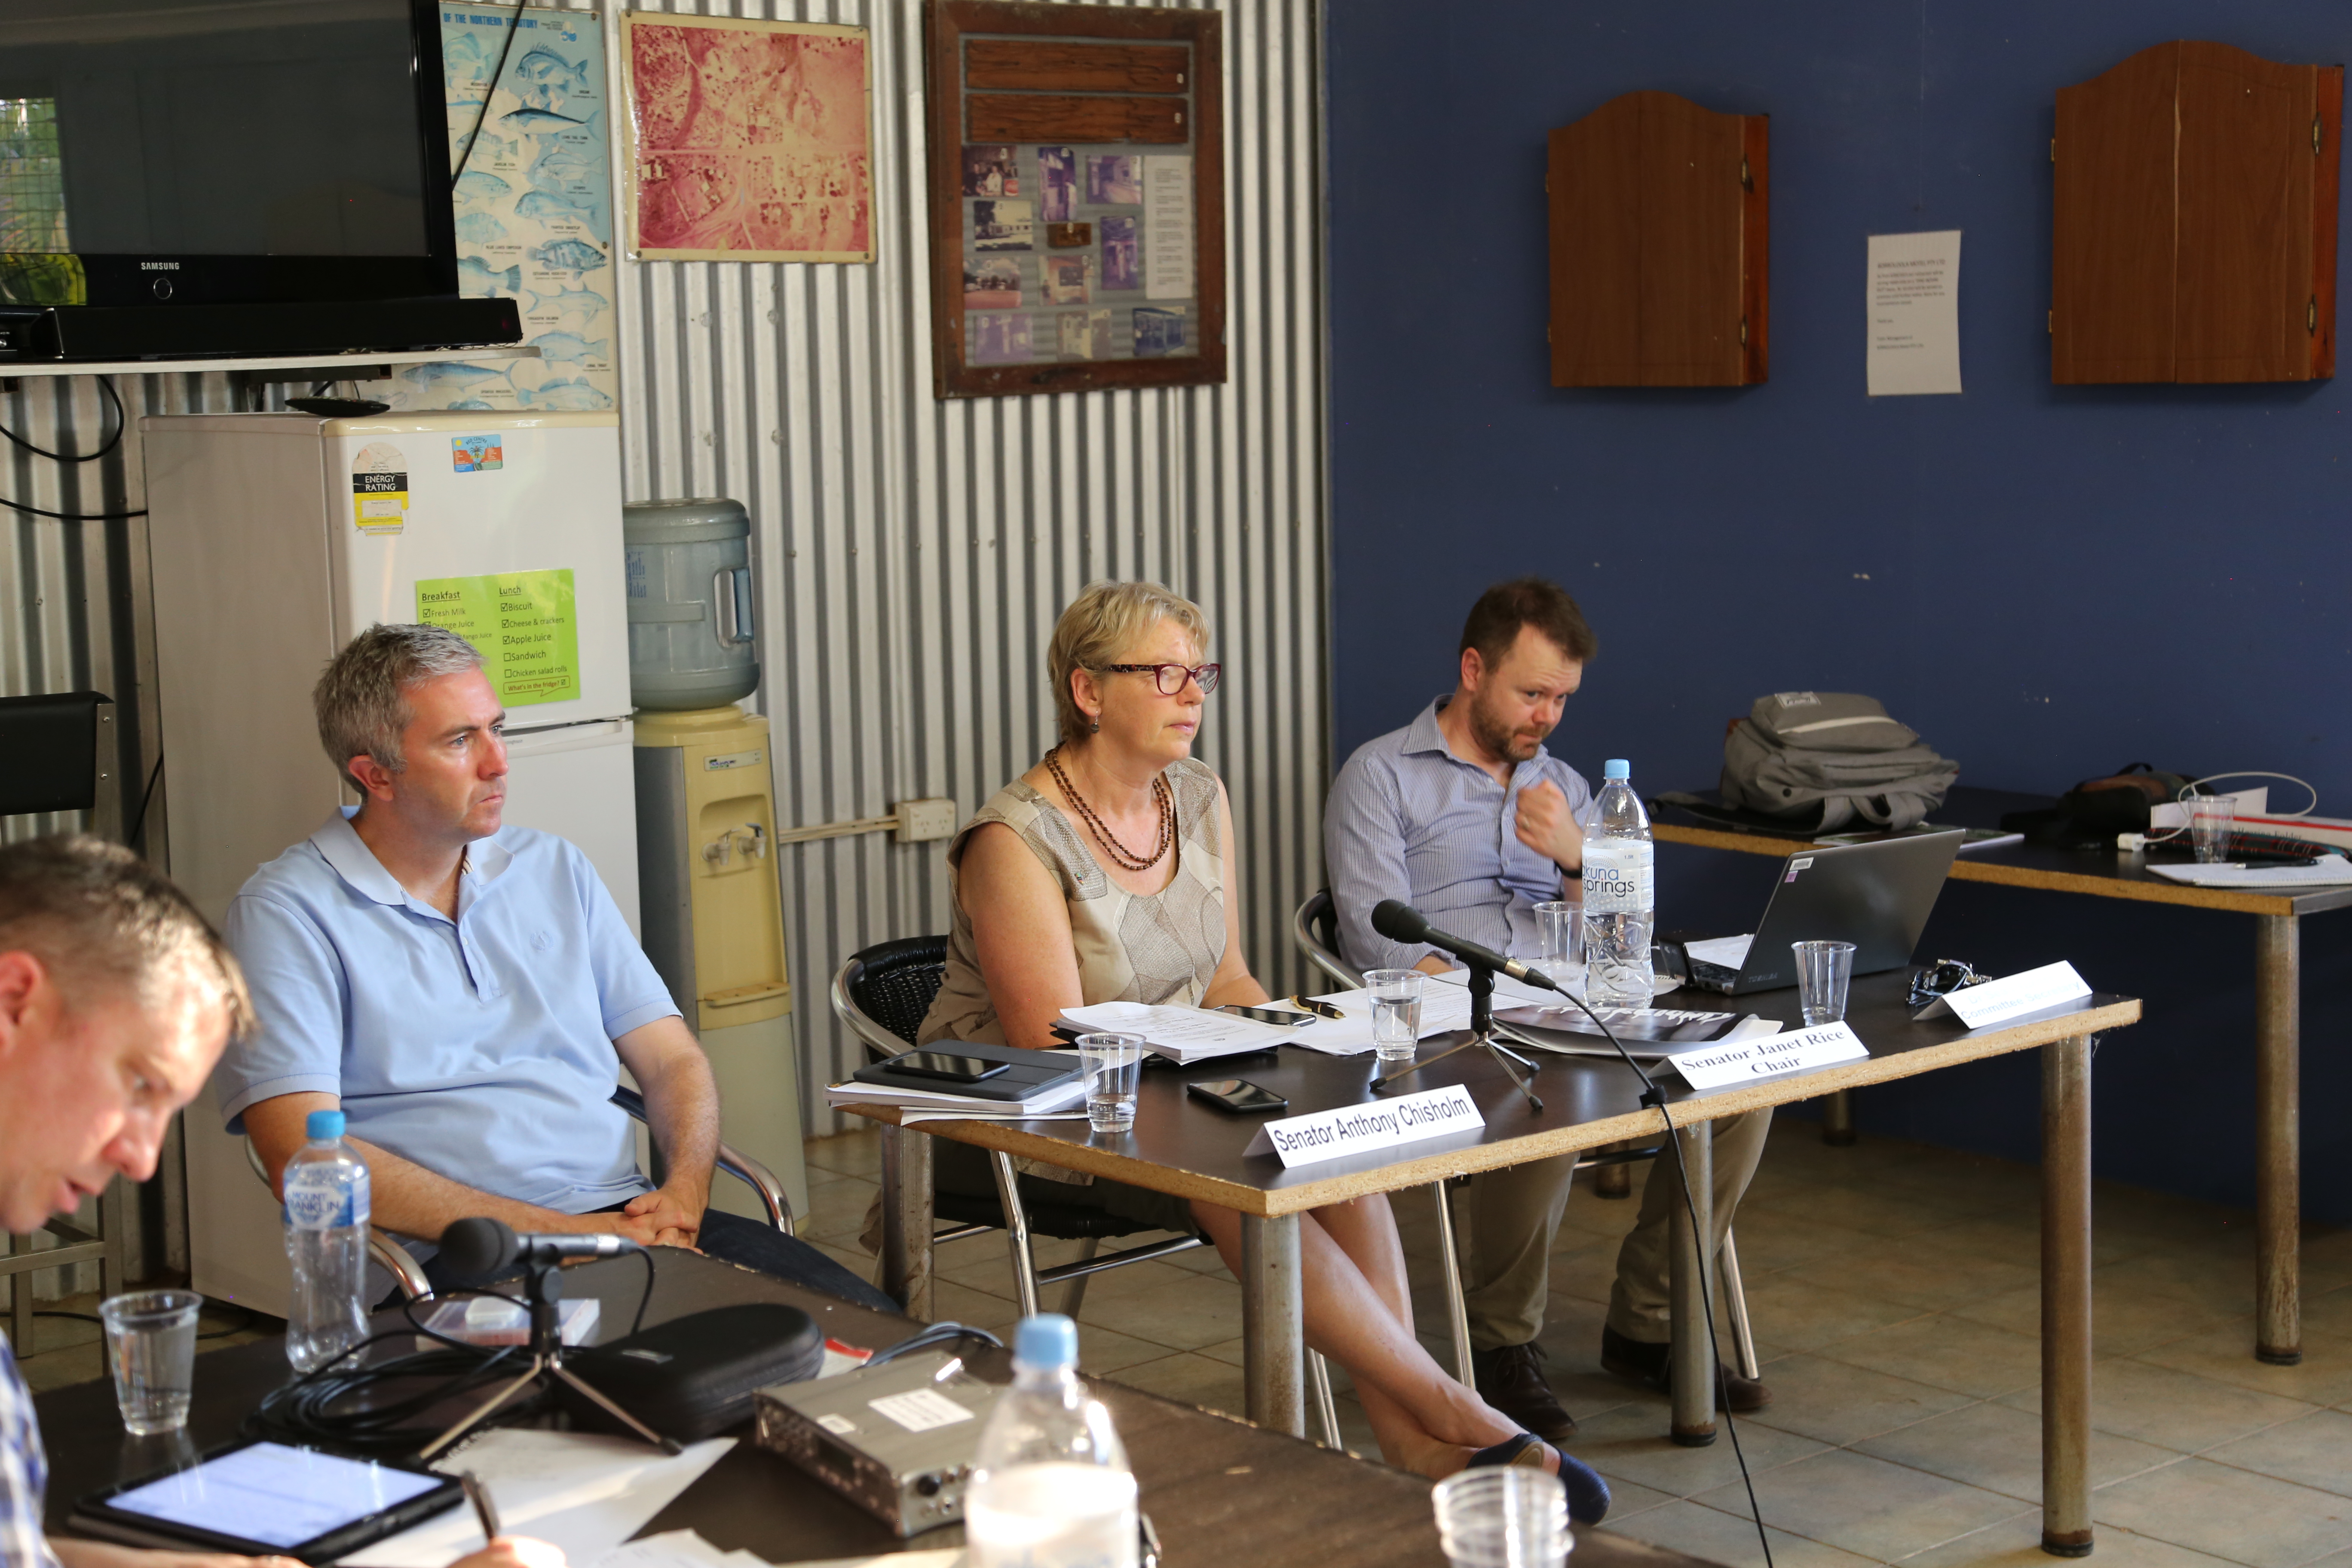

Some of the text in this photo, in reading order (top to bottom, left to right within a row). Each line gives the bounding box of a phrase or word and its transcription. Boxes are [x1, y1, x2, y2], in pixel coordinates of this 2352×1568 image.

[455, 13, 466, 24] THE
[469, 15, 502, 26] NORTHERN
[365, 475, 395, 484] ENERGY
[365, 483, 396, 491] RATING
[499, 586, 521, 595] Lunch
[422, 591, 461, 602] Breakfast
[451, 608, 466, 616] Milk
[508, 602, 533, 611] Biscuit
[540, 617, 564, 625] crackers
[511, 633, 551, 645] Apple Juice
[511, 650, 546, 661] Sandwich
[512, 668, 536, 677] Chicken
[538, 666, 553, 674] salad
[1583, 878, 1635, 897] springs
[1960, 980, 2081, 1020] Committee Secretary
[1681, 1031, 1845, 1071] Senator Janet Rice
[1751, 1057, 1801, 1075] Chair
[1274, 1096, 1470, 1152] Senator Anthony Chisholm
[292, 1191, 328, 1200] MOUNT
